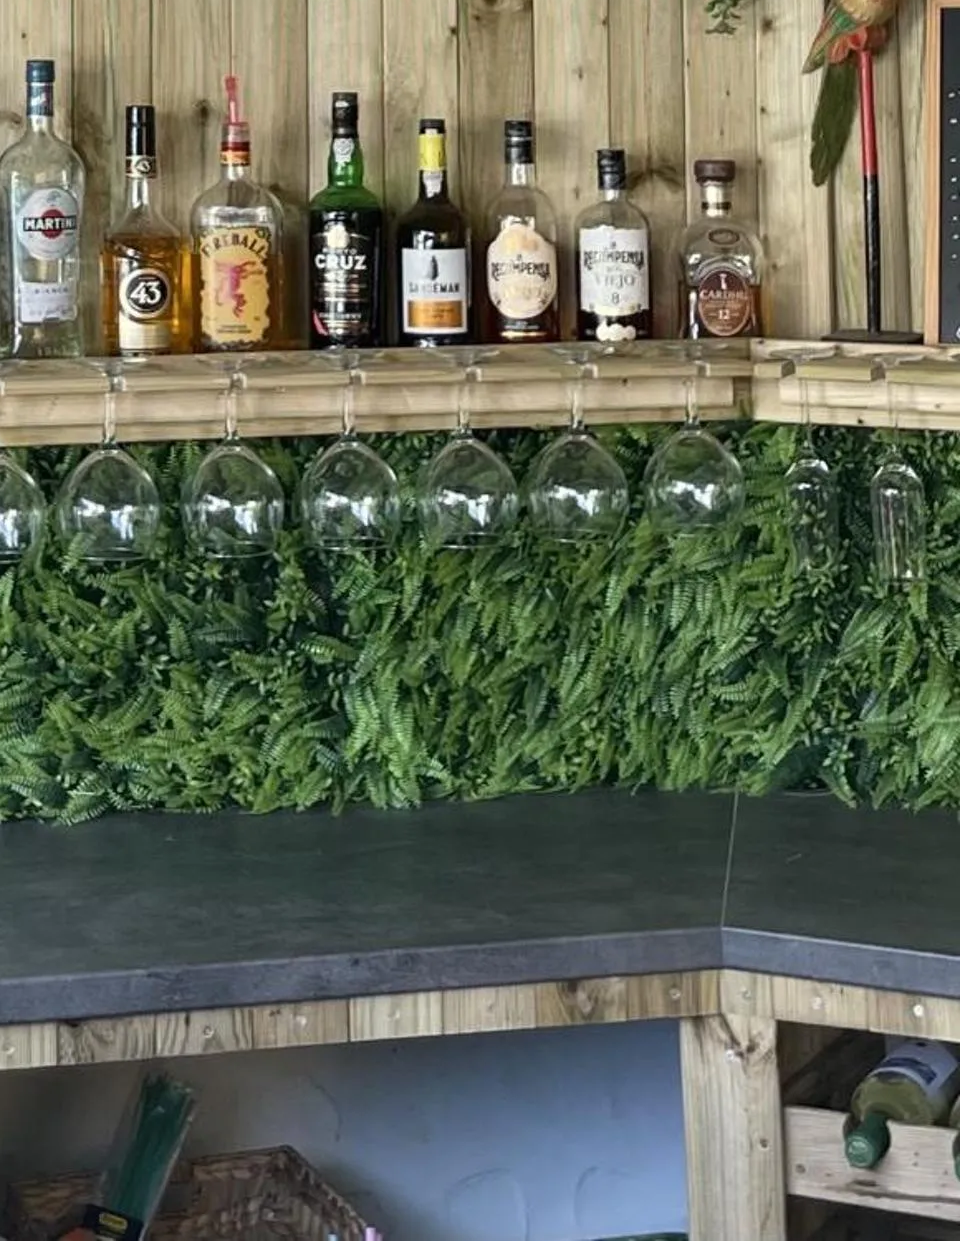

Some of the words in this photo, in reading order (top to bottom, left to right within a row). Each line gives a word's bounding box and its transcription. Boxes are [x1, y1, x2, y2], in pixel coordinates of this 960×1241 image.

[201, 233, 266, 257] FREBALL
[314, 254, 367, 270] CRUZ
[130, 281, 162, 304] 43
[409, 282, 460, 292] SAEMAN
